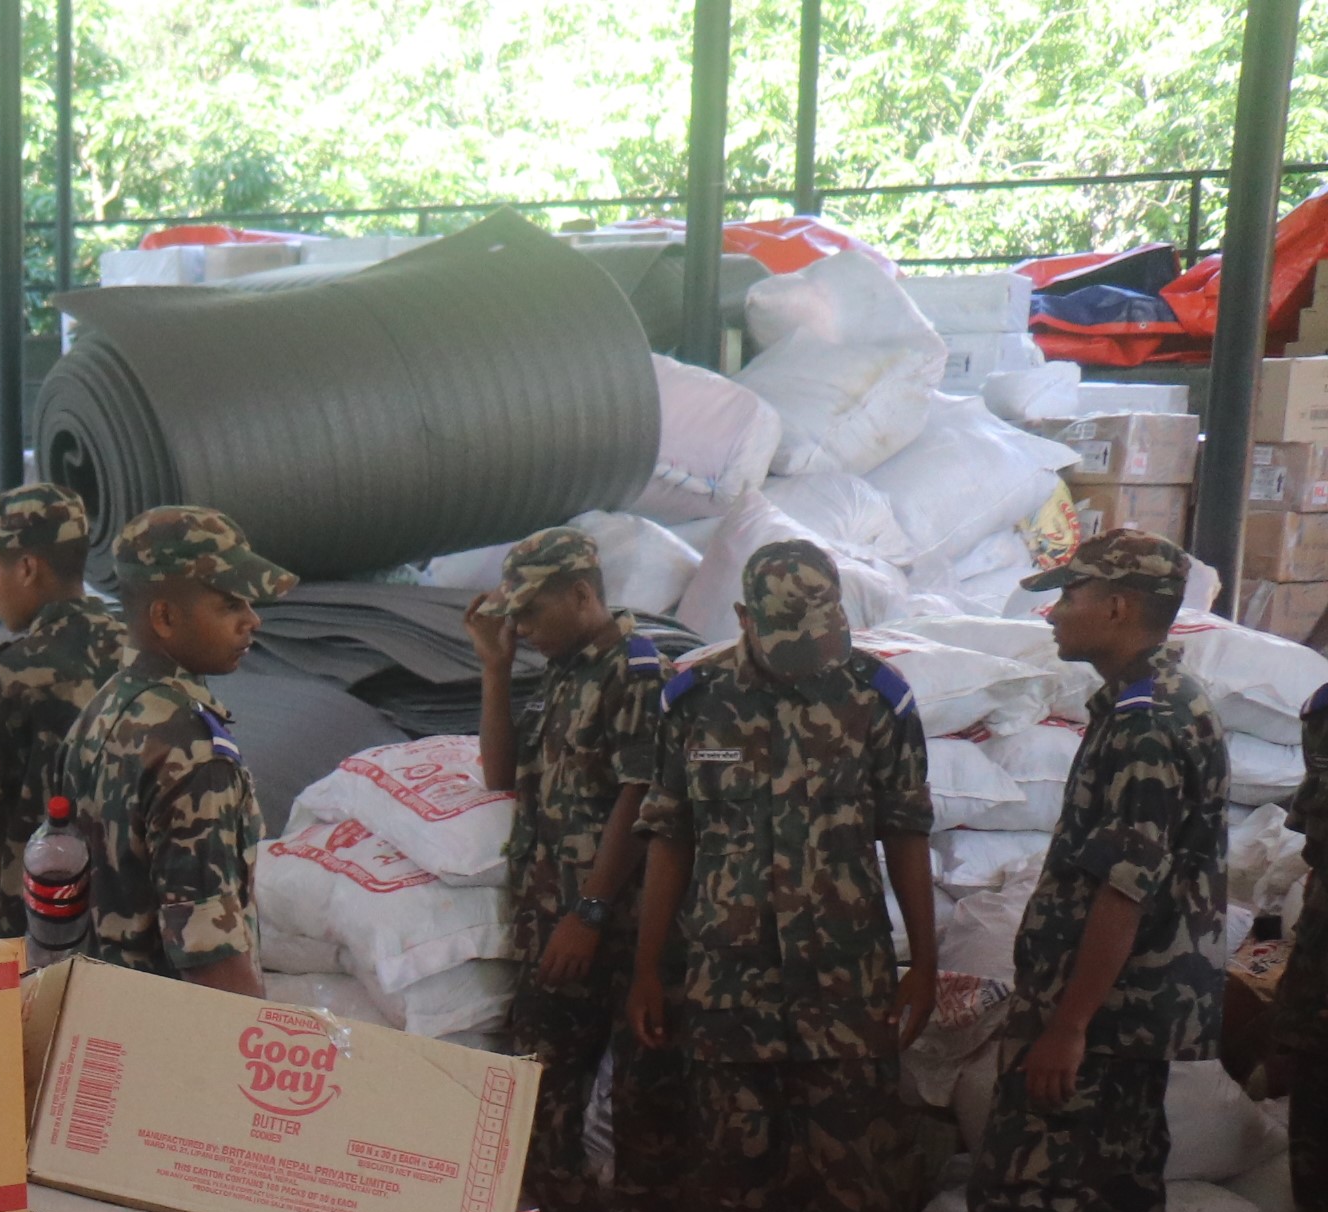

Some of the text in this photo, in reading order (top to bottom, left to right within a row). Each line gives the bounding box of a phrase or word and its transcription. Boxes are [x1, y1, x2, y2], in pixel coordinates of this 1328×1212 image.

[265, 1011, 321, 1032] BRITANNIA
[239, 1026, 338, 1072] Good
[245, 1060, 326, 1105] Day
[252, 1113, 301, 1136] BUTTER
[138, 1129, 201, 1151] MANUFACTURED
[221, 1145, 276, 1167] BRITANNIA
[279, 1157, 312, 1174] NEPAL
[315, 1165, 357, 1183] PRIVATE
